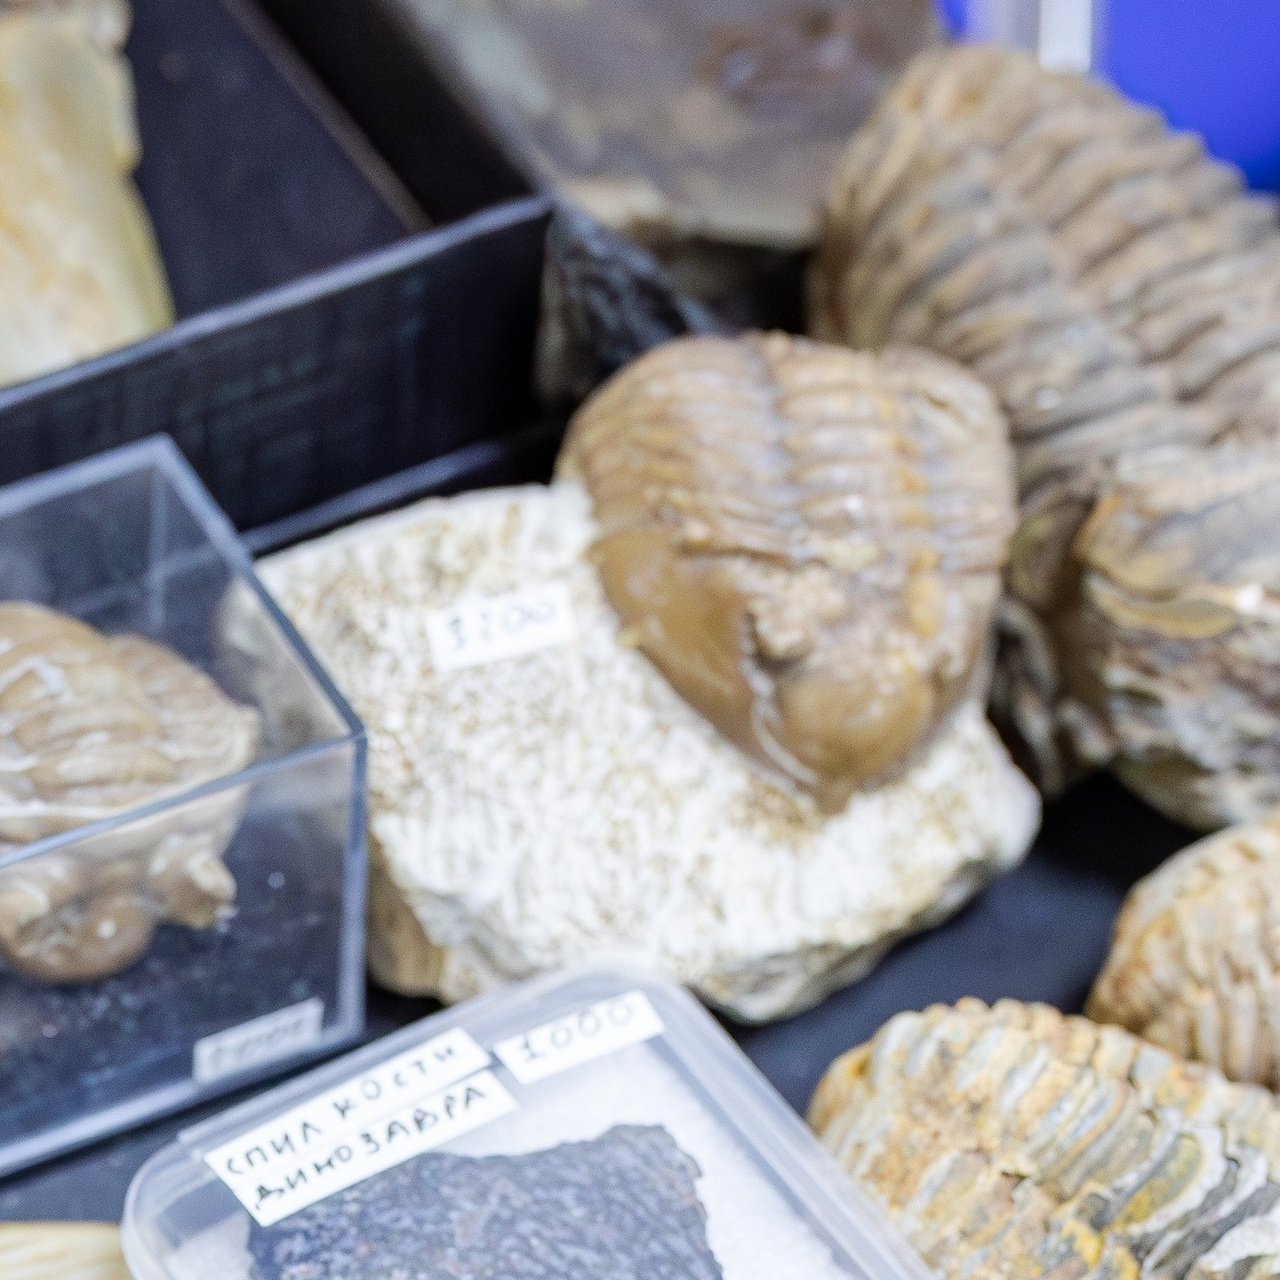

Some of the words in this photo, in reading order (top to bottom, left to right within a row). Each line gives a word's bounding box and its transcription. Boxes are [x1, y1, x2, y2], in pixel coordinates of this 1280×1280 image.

[521, 1001, 636, 1064] 1000
[225, 1121, 322, 1176] СПИЛ
[333, 1043, 458, 1121] КОСТИ
